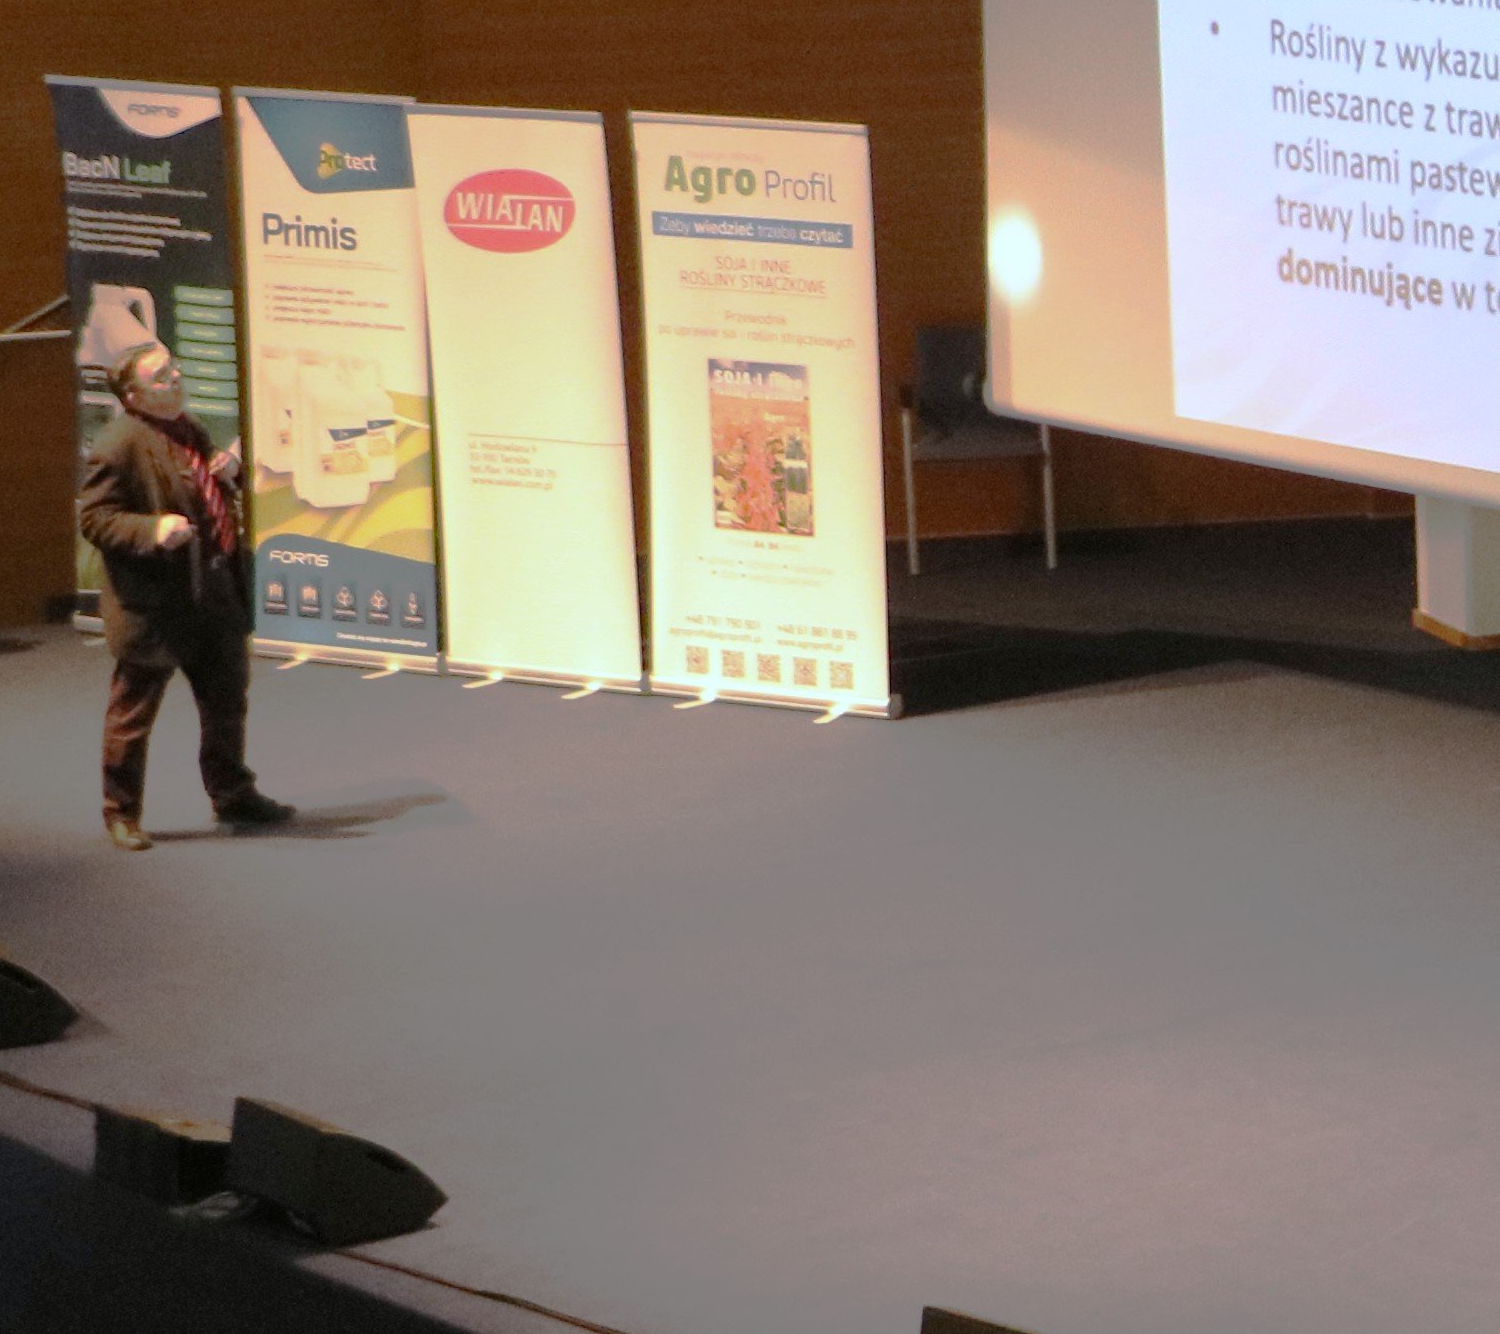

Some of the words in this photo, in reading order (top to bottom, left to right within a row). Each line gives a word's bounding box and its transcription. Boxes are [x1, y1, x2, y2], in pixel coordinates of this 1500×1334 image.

[1270, 18, 1366, 73] Rośliny
[1395, 37, 1499, 82] wykazu
[1272, 79, 1414, 129] mieszance
[664, 154, 756, 203] Agro
[764, 169, 836, 203] Profil
[1274, 136, 1399, 184] roślinami
[262, 212, 357, 251] Primis
[455, 192, 565, 234] WIALAN
[1275, 193, 1353, 243] trawy
[1362, 201, 1405, 242] lub
[1413, 208, 1474, 253] inne
[1277, 247, 1443, 310] dominujące
[269, 550, 329, 567] FORTIS
